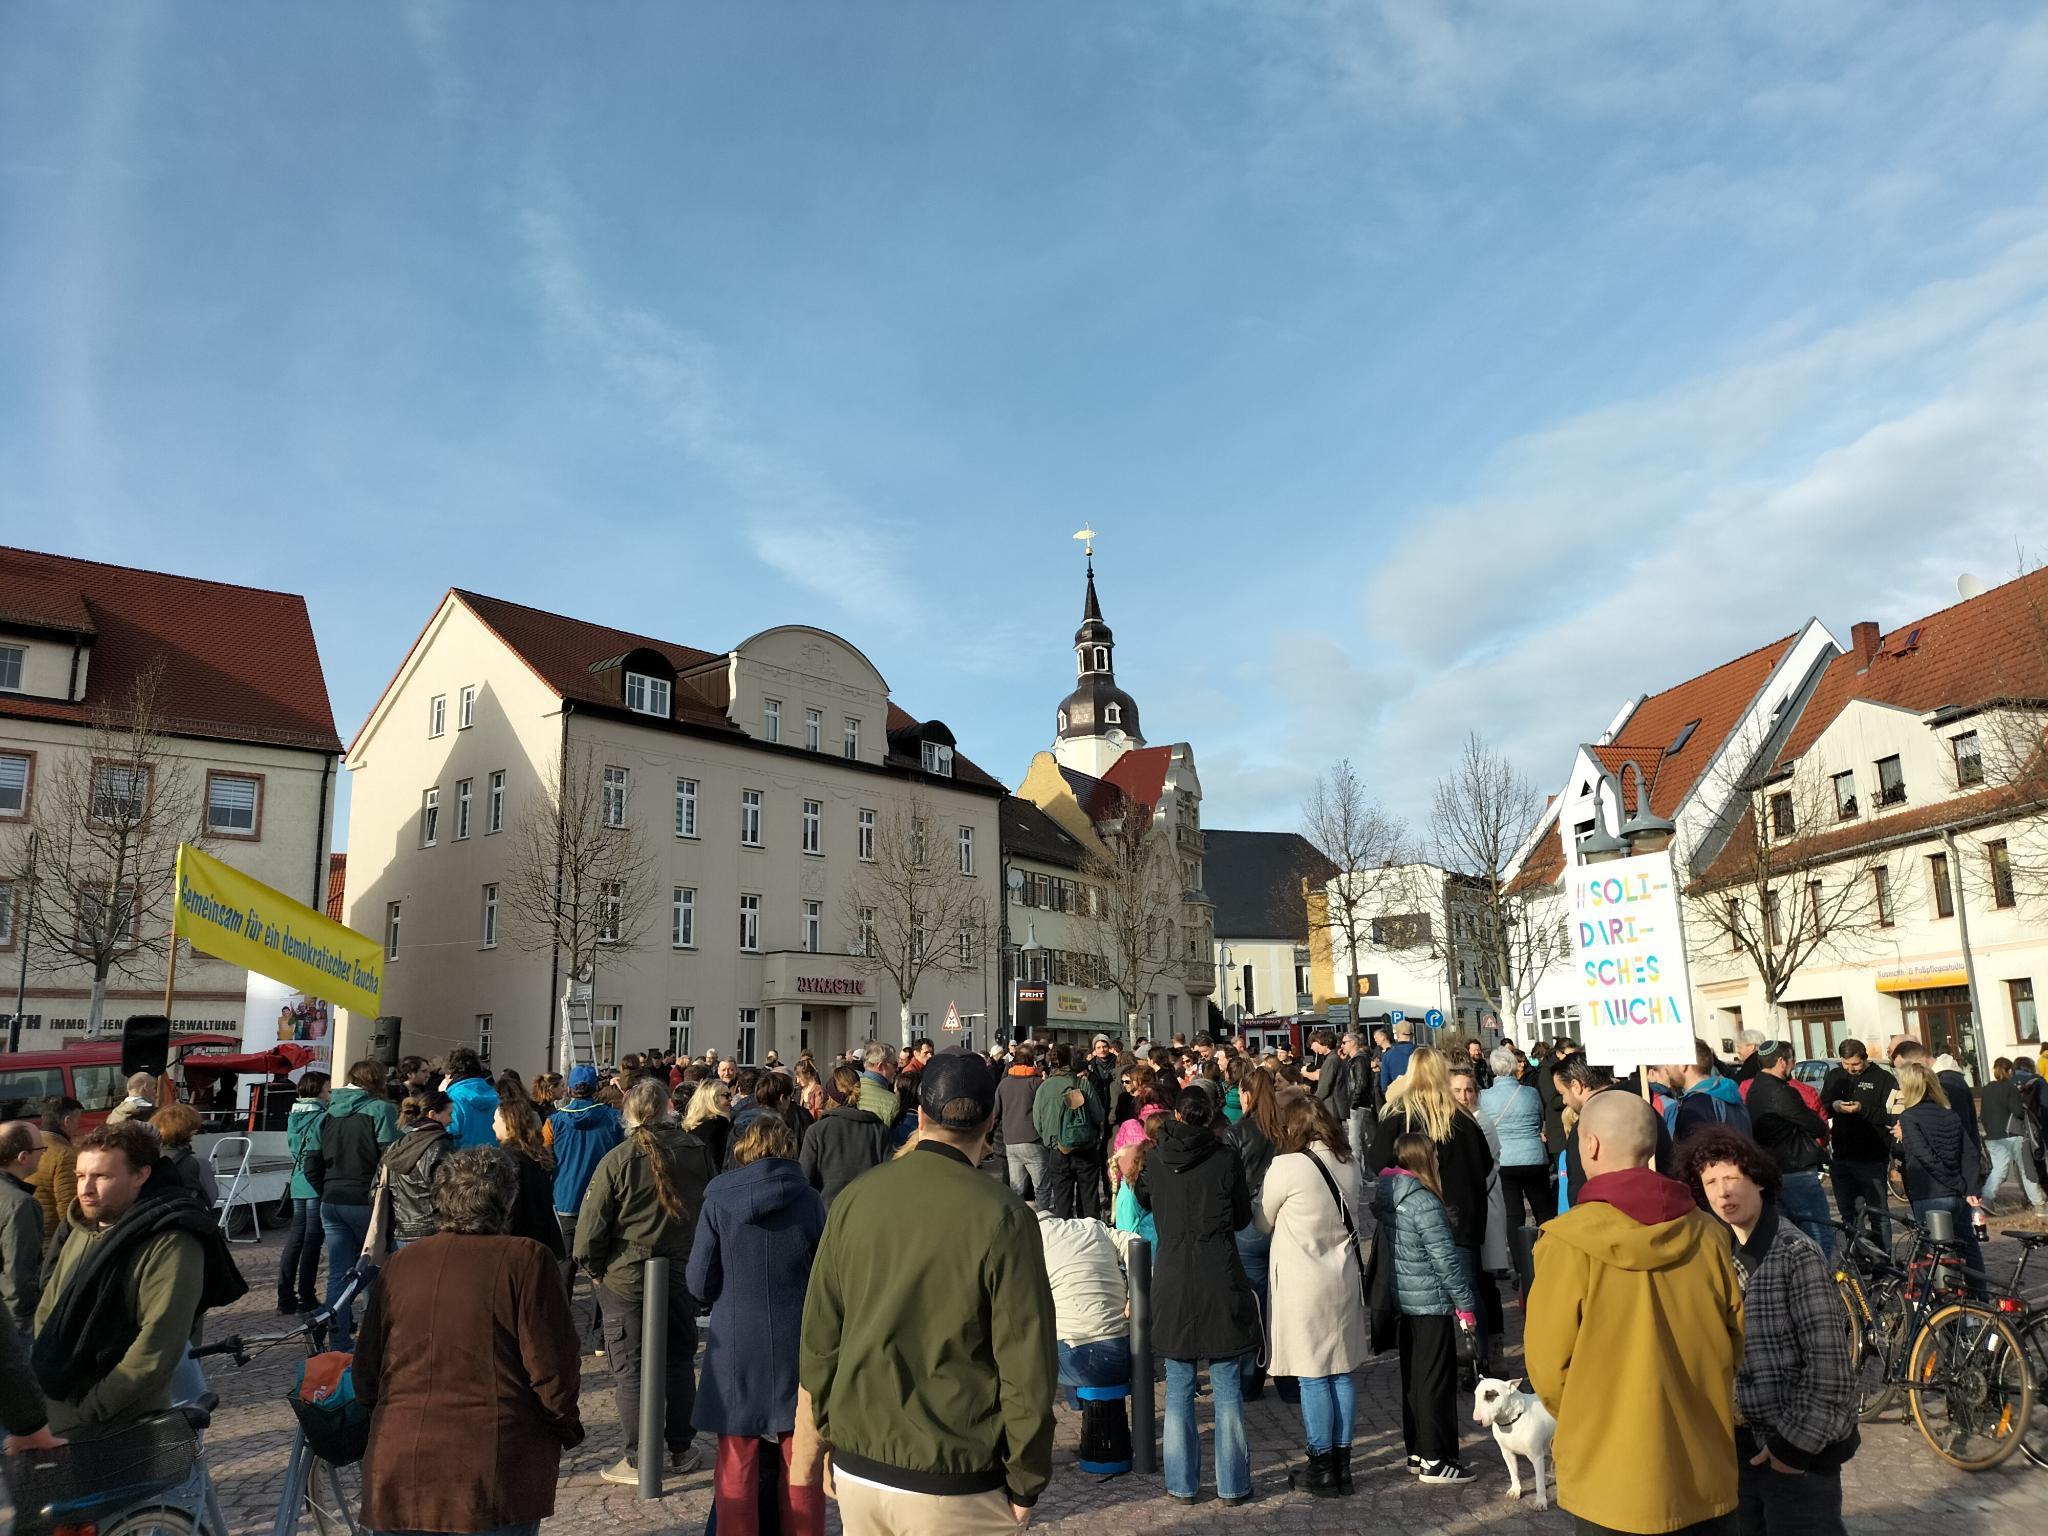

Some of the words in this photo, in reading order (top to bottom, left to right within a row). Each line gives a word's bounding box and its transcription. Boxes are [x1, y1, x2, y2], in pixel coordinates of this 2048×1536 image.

[180, 874, 243, 934] Gemeinsam
[244, 908, 263, 942] für
[264, 923, 280, 950] ein
[281, 925, 352, 983] demokratisches
[352, 958, 379, 994] Taucha
[1579, 916, 1654, 948] DARI-
[1584, 955, 1660, 986] SCHES
[49, 1018, 123, 1030] IMMOIEN
[170, 1019, 237, 1031] ERWALTUNG
[1393, 1012, 1402, 1022] P
[1588, 996, 1682, 1026] TAUCHA
